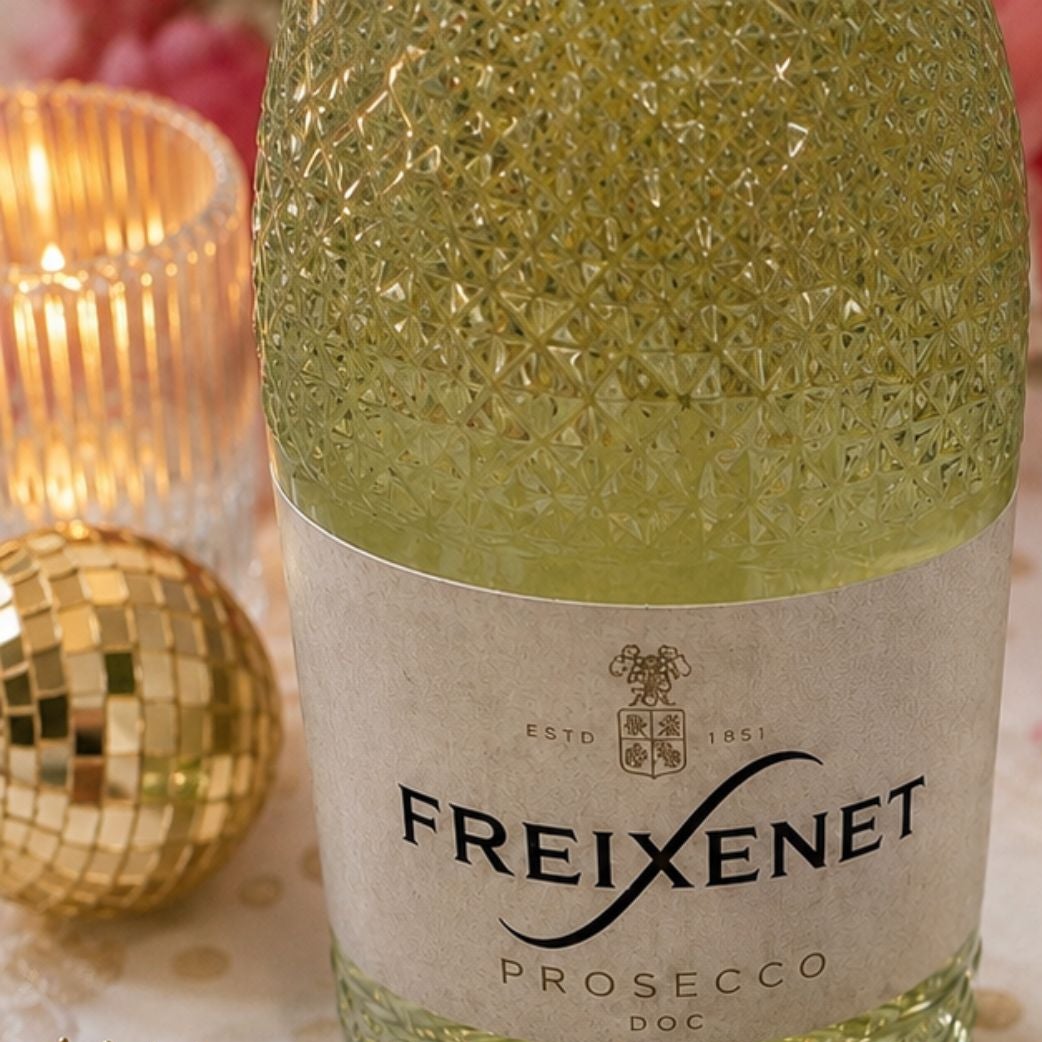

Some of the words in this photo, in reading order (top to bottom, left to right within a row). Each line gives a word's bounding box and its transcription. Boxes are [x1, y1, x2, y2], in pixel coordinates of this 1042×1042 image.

[526, 723, 595, 745] ESTD
[707, 726, 766, 745] 1851
[399, 751, 925, 949] FREIXENET
[500, 952, 827, 998] PROSECCO
[630, 1013, 704, 1032] DOC
